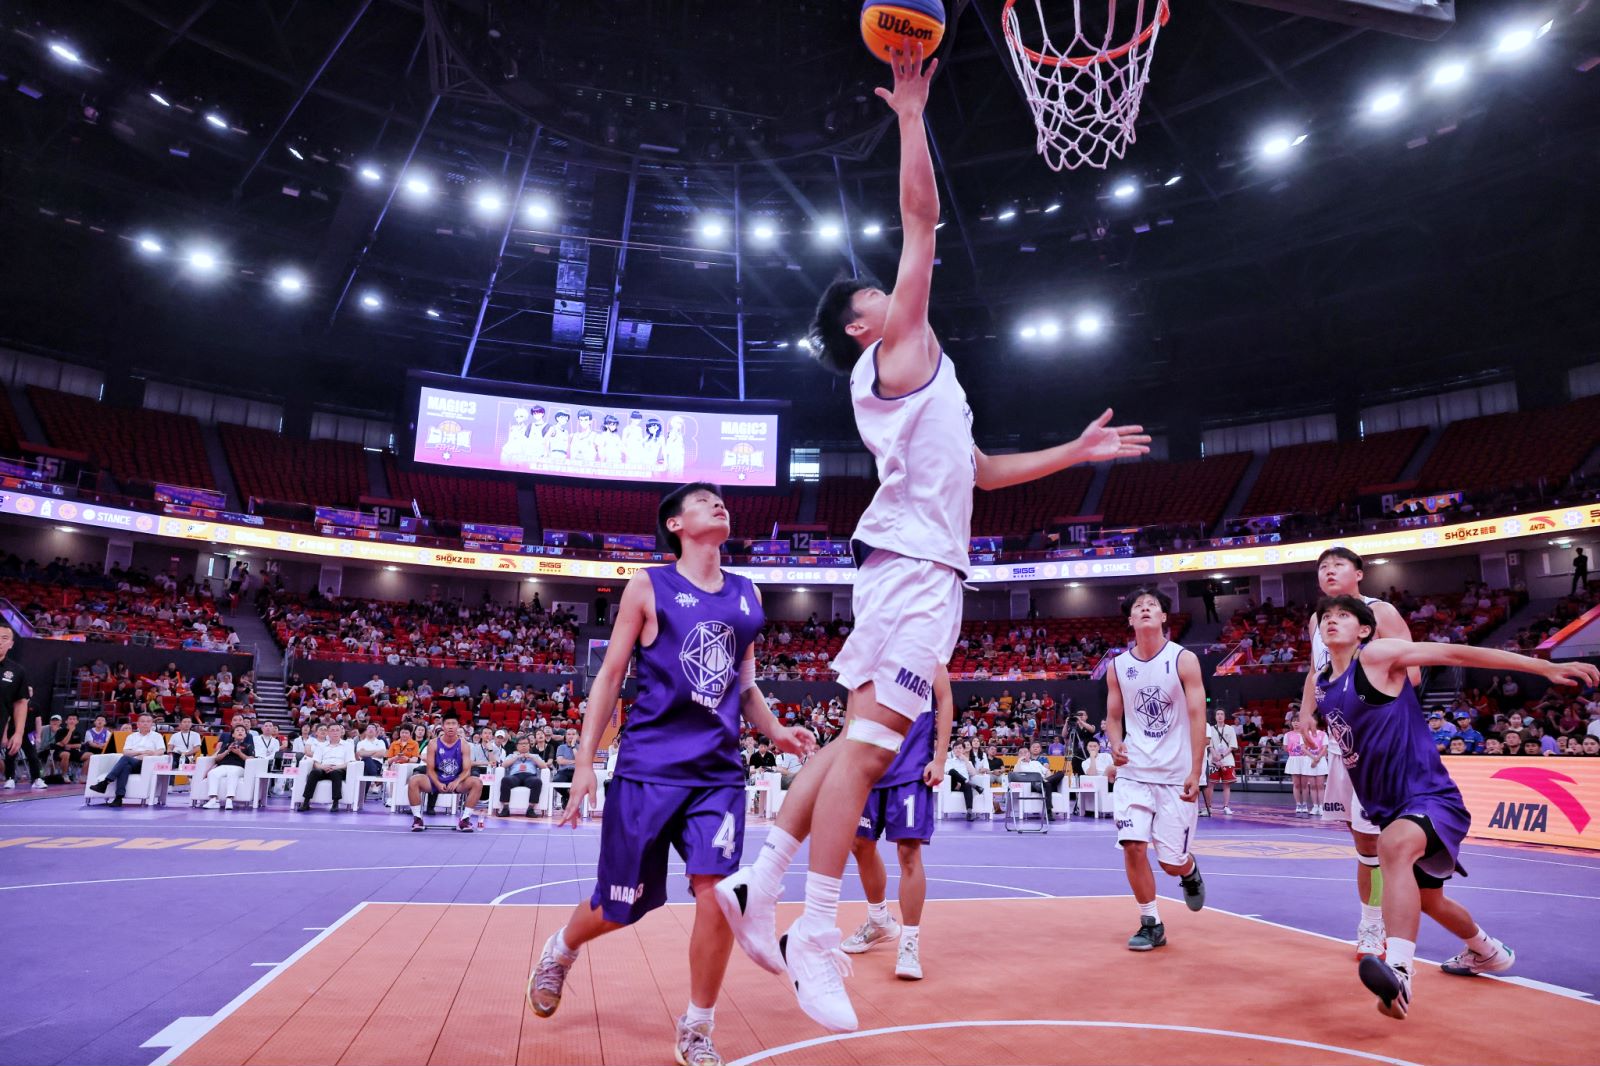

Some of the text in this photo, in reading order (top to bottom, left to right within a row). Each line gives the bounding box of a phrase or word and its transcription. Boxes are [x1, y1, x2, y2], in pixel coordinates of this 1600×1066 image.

[877, 11, 933, 40] Wilson
[427, 396, 477, 415] MAGIC3
[720, 421, 767, 435] MAGIC3
[97, 513, 132, 526] STANCE
[1444, 528, 1479, 540] SHOKZ
[1529, 523, 1545, 531] ANTA
[435, 553, 462, 564] SHOKZ
[539, 561, 562, 569] SIGG
[1013, 567, 1035, 575] SIGG
[1103, 563, 1131, 573] STANCE
[740, 595, 750, 616] 4
[1165, 660, 1170, 674] 1
[903, 794, 915, 828] 1
[1488, 801, 1548, 833] ANTA
[712, 811, 736, 860] 4
[1182, 826, 1190, 854] 1
